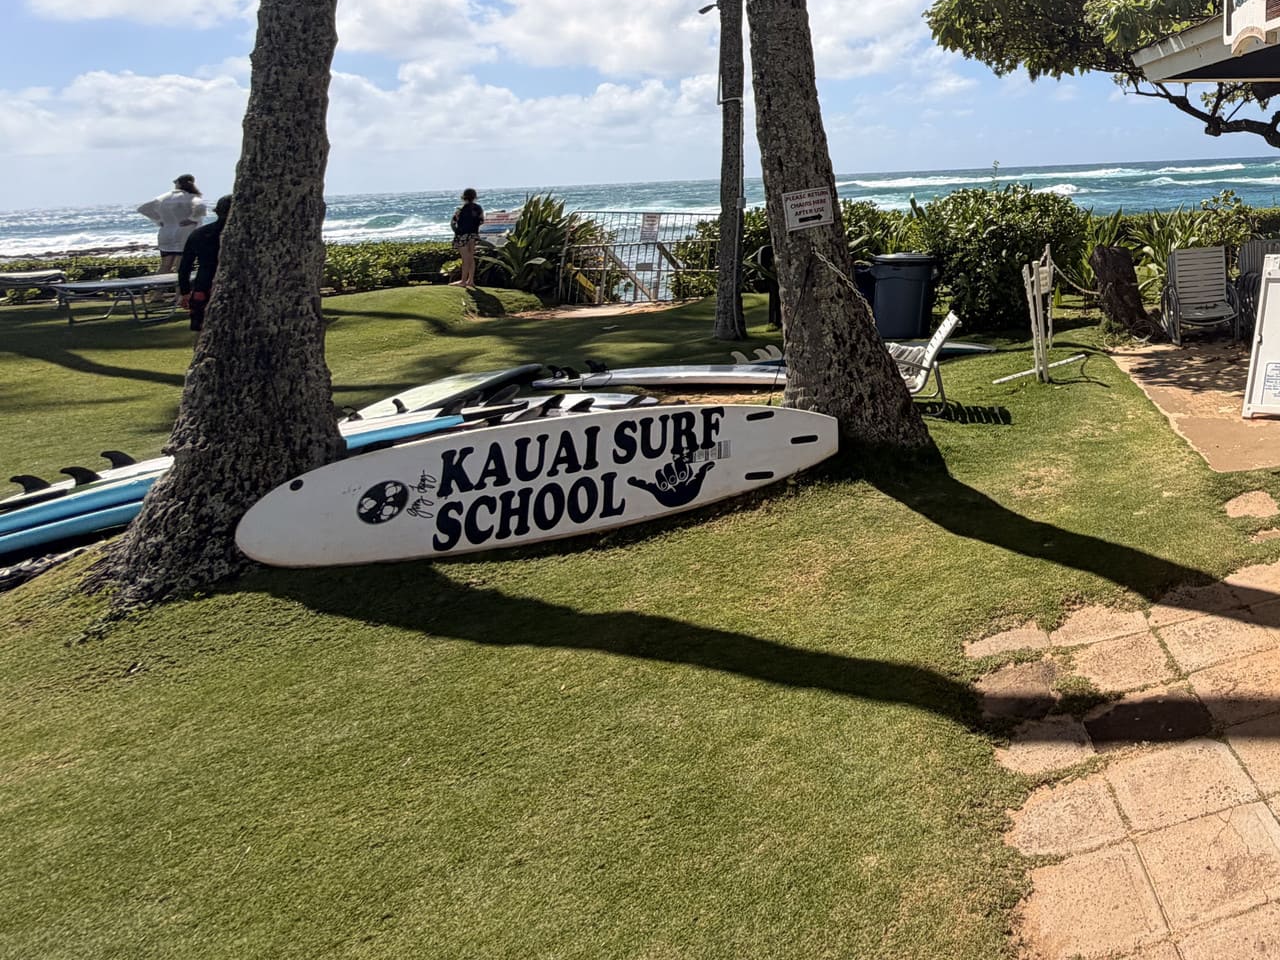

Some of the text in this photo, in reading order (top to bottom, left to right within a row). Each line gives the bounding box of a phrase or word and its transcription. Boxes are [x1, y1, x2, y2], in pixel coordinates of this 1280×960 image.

[437, 407, 724, 497] KAUAI SURF
[433, 472, 626, 551] SCHOOL
